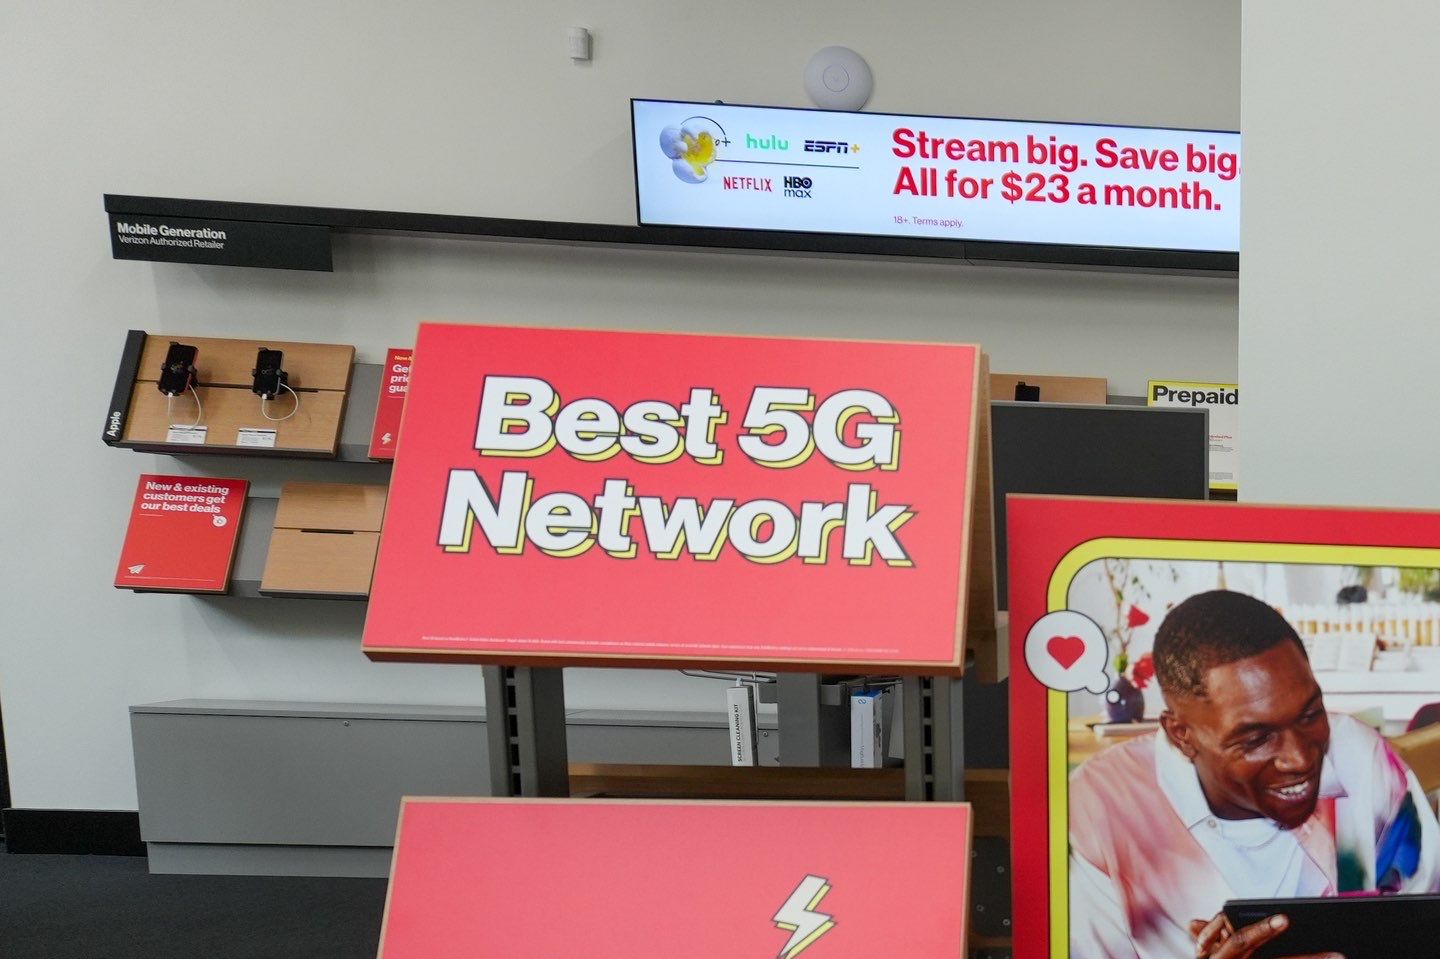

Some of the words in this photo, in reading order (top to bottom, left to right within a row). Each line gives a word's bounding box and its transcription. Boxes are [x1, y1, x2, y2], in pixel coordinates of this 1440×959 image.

[746, 133, 789, 150] hulu
[892, 128, 1019, 163] Stream
[1027, 135, 1088, 172] big.
[1095, 138, 1178, 171] Save
[1187, 143, 1240, 180] big
[723, 176, 772, 192] NETFLIX
[784, 176, 812, 189] HBO
[893, 166, 937, 196] All
[945, 169, 993, 199] for
[1001, 170, 1069, 204] $23
[1077, 184, 1097, 205] a
[1105, 181, 1221, 211] month.
[784, 189, 812, 198] max
[117, 222, 158, 235] Mobile
[159, 225, 226, 239] Generation
[913, 217, 938, 226] Terms
[940, 219, 964, 228] apply.
[119, 235, 149, 244] Verizon
[150, 237, 193, 247] Authorized
[194, 240, 224, 249] Retailer
[393, 364, 409, 373] Ge
[1153, 385, 1239, 406] Prepaid
[106, 411, 121, 437] Apple
[474, 375, 728, 465] Best
[737, 386, 901, 471] 5G
[146, 482, 172, 490] New
[173, 483, 182, 491] &
[184, 485, 229, 495] existing
[143, 493, 205, 502] customers
[206, 496, 226, 504] get
[162, 502, 188, 511] best
[189, 504, 221, 513] deals
[437, 469, 919, 568] Network
